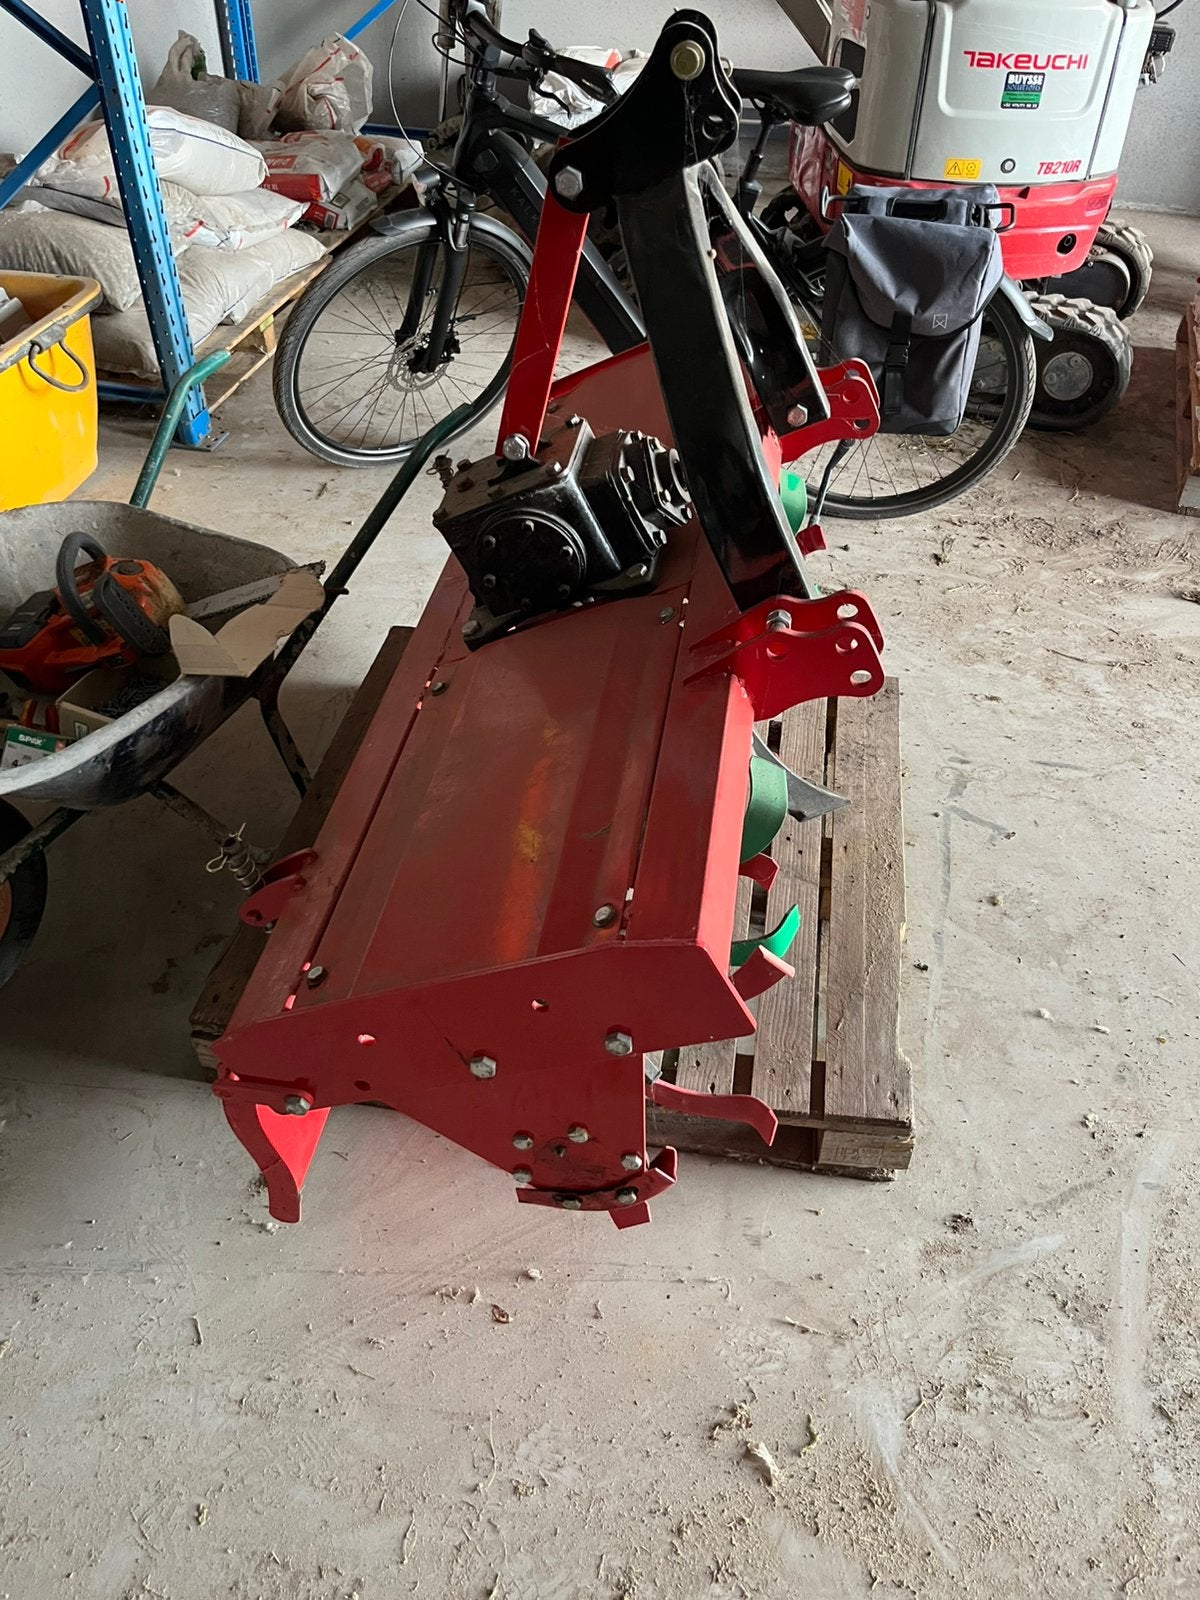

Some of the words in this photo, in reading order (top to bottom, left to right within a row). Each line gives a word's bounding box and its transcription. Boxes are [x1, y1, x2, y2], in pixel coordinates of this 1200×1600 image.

[1007, 74, 1044, 85] BUYSSE
[1037, 160, 1082, 175] TB210R
[18, 734, 43, 746] SPAX
